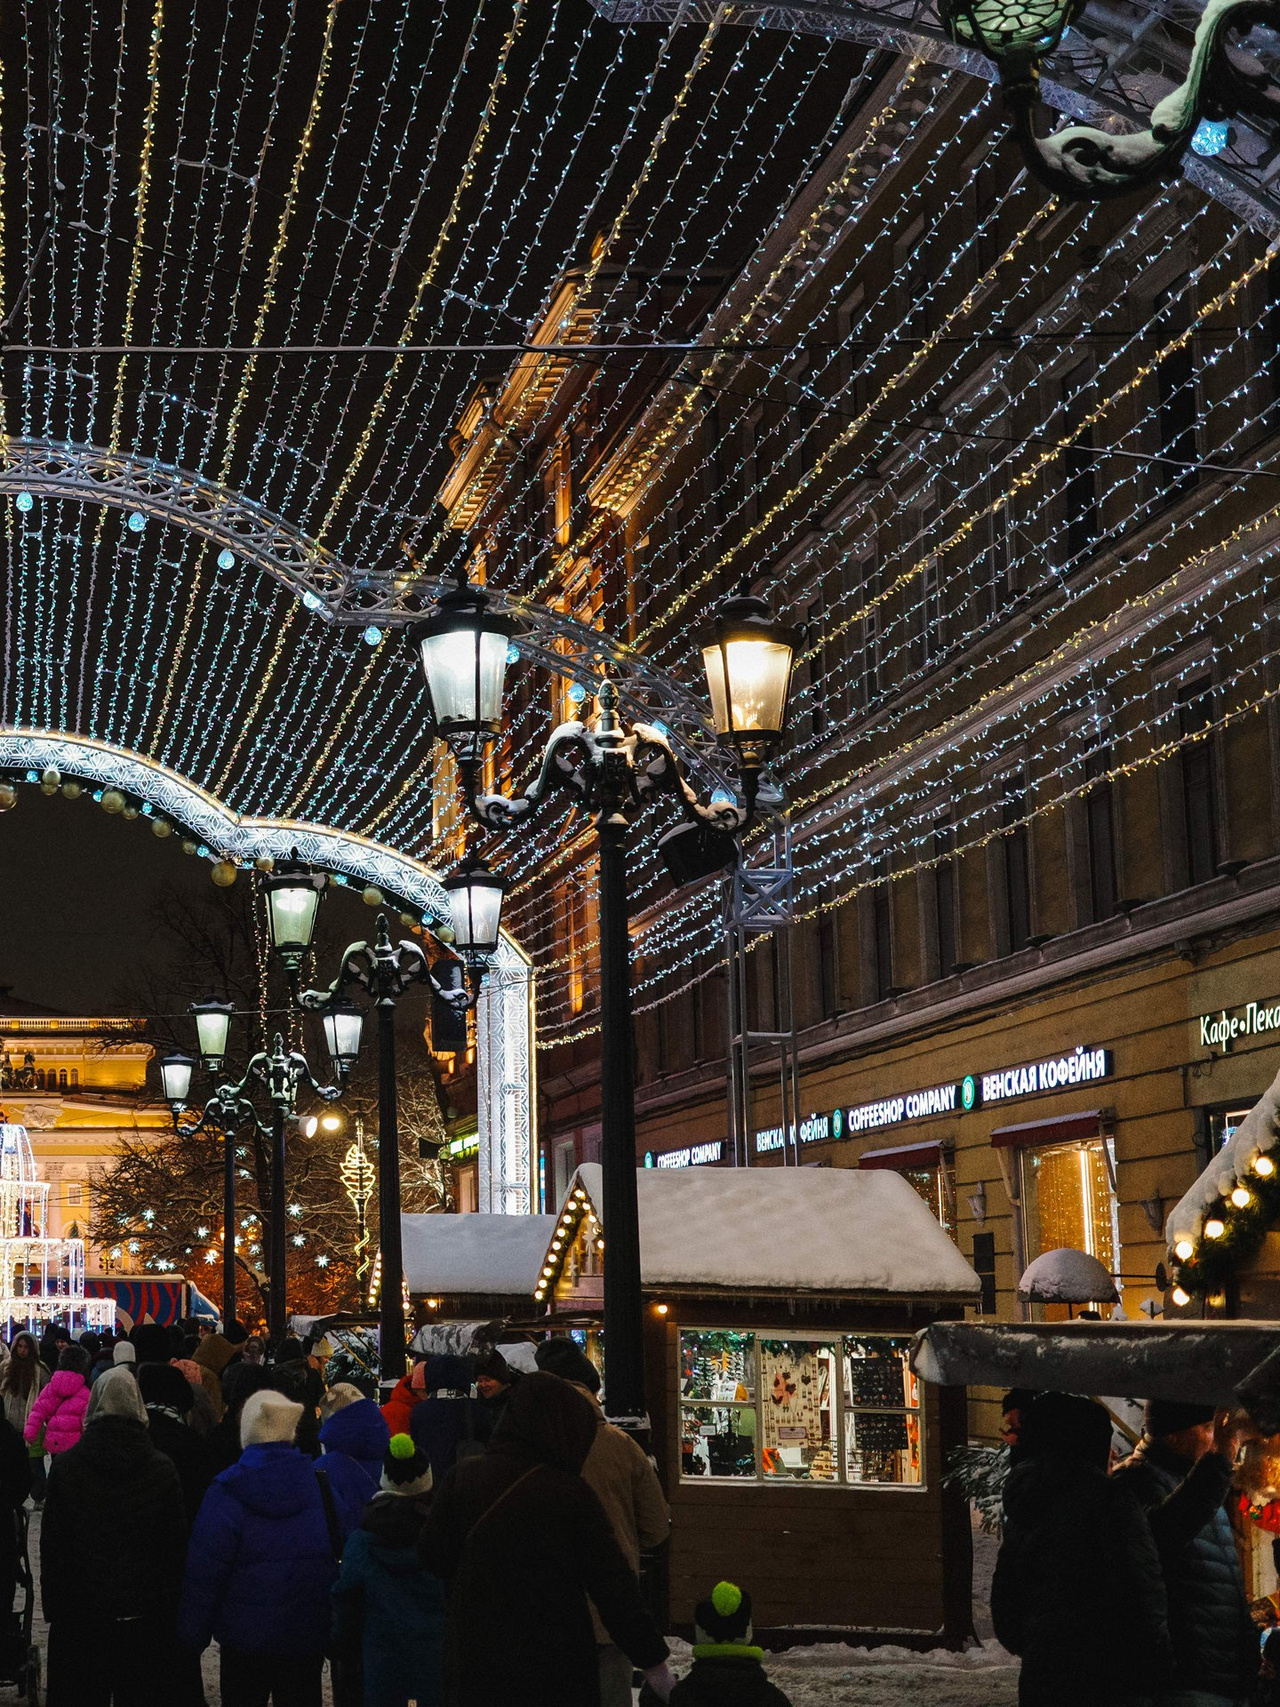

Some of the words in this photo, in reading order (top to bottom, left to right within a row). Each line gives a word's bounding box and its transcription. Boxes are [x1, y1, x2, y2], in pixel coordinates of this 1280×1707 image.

[982, 1065, 1037, 1101] ВЕНСКАЯ
[1039, 1046, 1106, 1090] КОФЕЙНЯ
[848, 1097, 904, 1132] COFFEESHOP
[906, 1085, 956, 1117] COMPANY
[756, 1127, 785, 1153] ВЕНСКА
[789, 1113, 829, 1143] КФЕЙНЯ
[657, 1148, 690, 1169] COFFEESHOP
[691, 1141, 722, 1165] COMPANY
